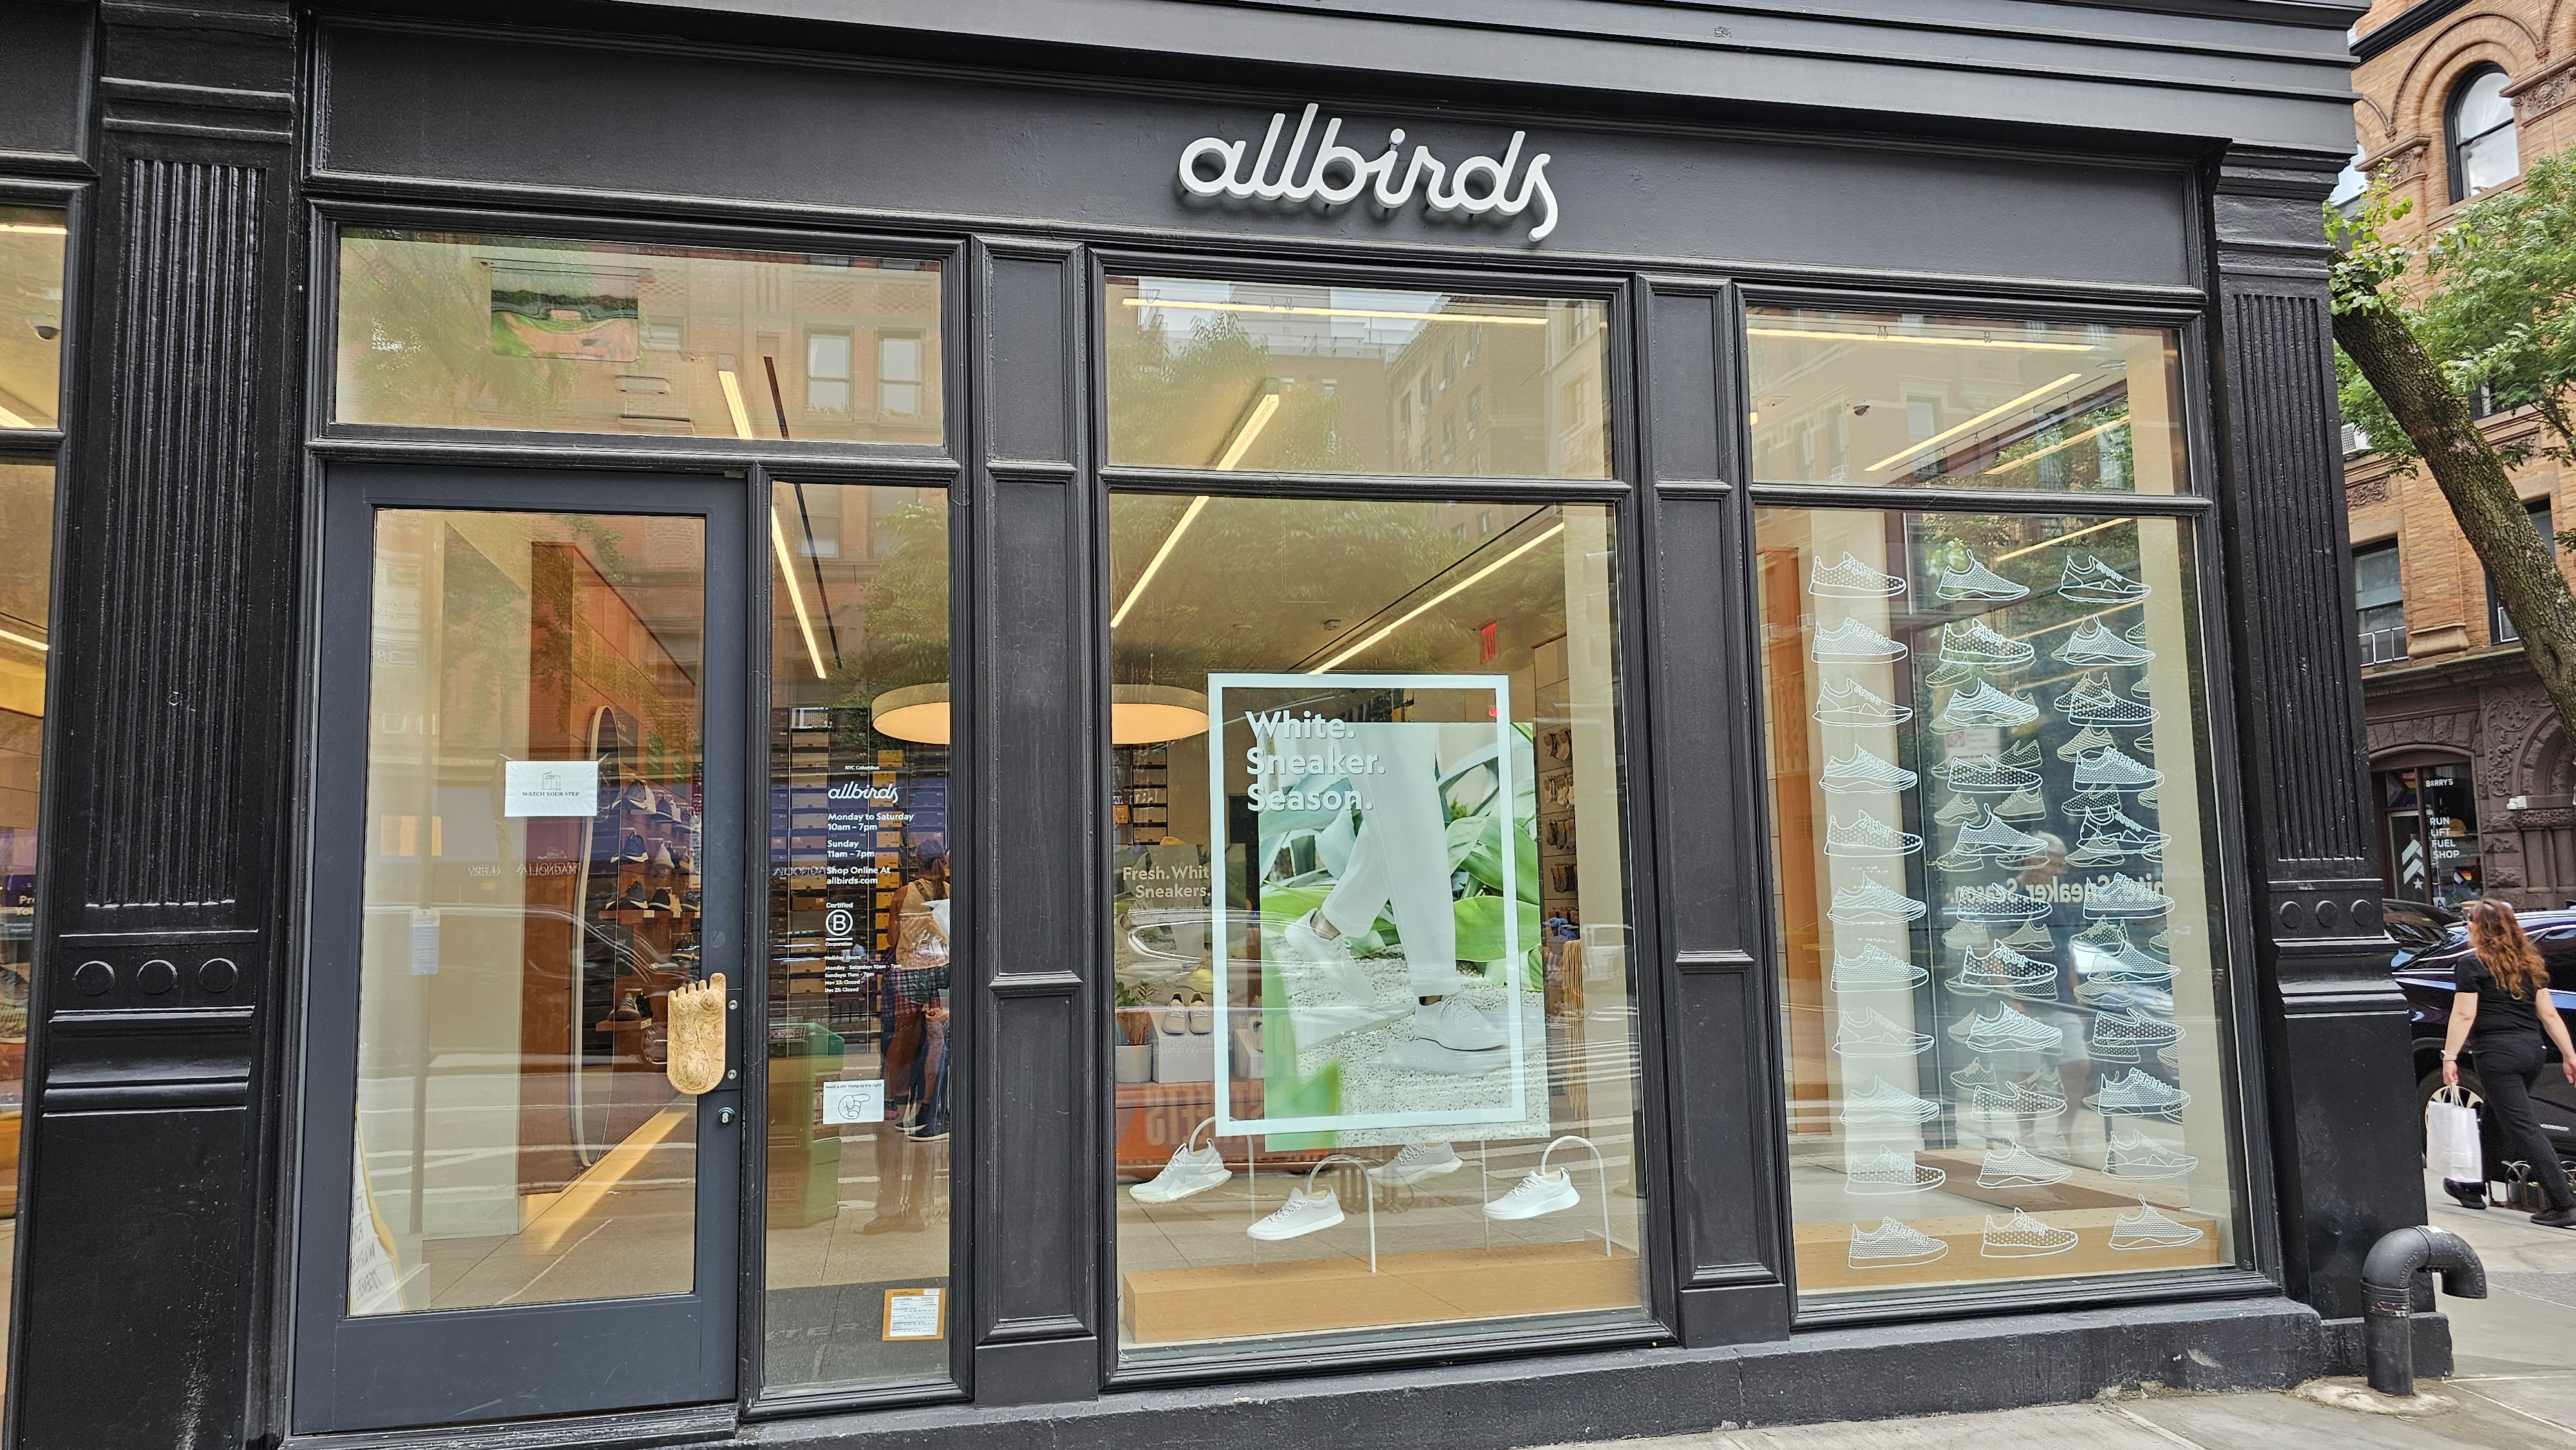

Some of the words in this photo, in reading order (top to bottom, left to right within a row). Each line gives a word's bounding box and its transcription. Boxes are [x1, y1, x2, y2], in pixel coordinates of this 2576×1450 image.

[1178, 103, 1558, 242] allbirds
[1244, 710, 1356, 739] White.
[1246, 746, 1387, 775] Sneaker.
[828, 780, 899, 804] allbirds
[1247, 783, 1373, 811] Season.
[828, 813, 864, 822] Monday
[876, 812, 914, 822] Saturday
[2429, 816, 2450, 825] RUN
[858, 823, 878, 833] 7pm
[2430, 828, 2451, 836] LIFT
[827, 839, 859, 849] Sunday
[2431, 839, 2456, 848] FUEL
[855, 850, 875, 859] 7pm
[2432, 850, 2460, 859] SHOP
[826, 865, 849, 876] Shop
[850, 866, 878, 874] Online
[880, 866, 891, 874] At
[1122, 865, 1170, 880] Fresh.
[1171, 865, 1212, 880] Whit
[826, 876, 878, 885] allbirds.com
[1135, 883, 1211, 899] Sneakers.
[2438, 899, 2446, 909] A
[833, 914, 846, 931] B
